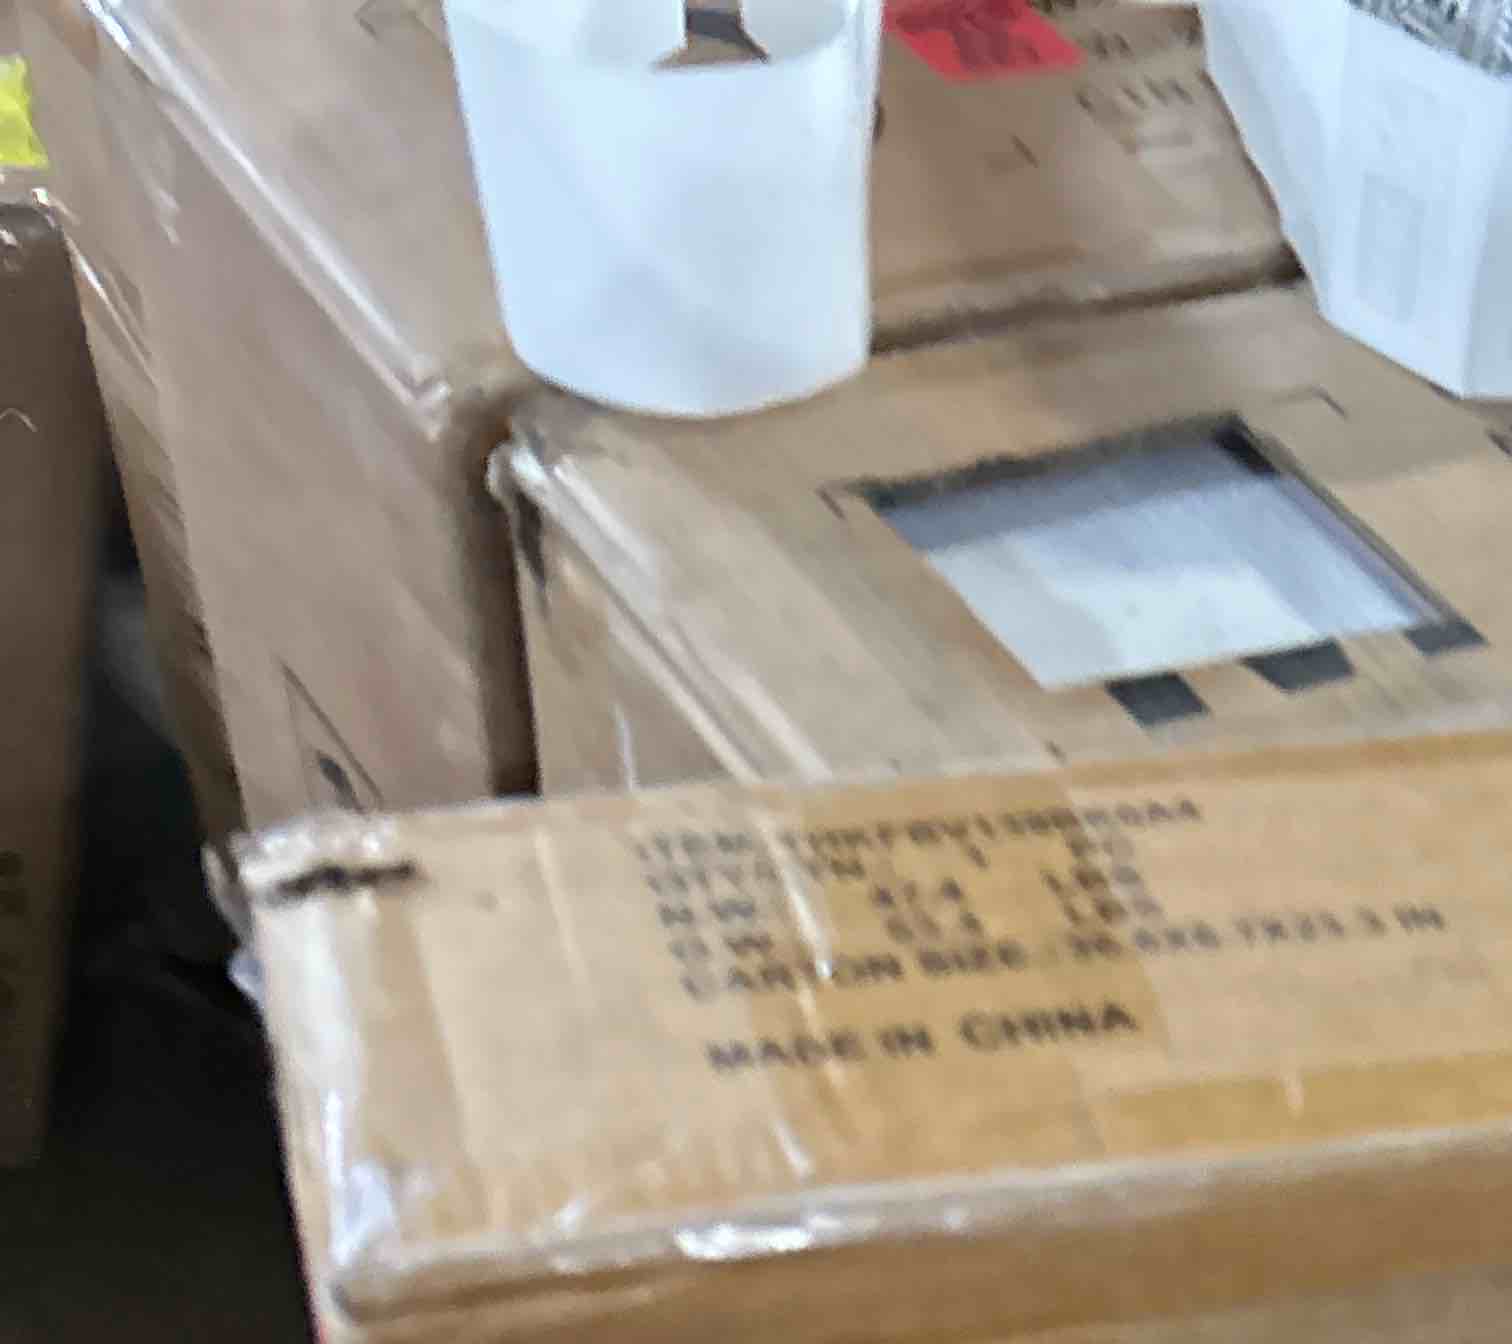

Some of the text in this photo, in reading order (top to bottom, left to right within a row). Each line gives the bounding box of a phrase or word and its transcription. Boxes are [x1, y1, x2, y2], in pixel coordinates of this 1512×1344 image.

[705, 1002, 1142, 1070] MADE IN CHINA
